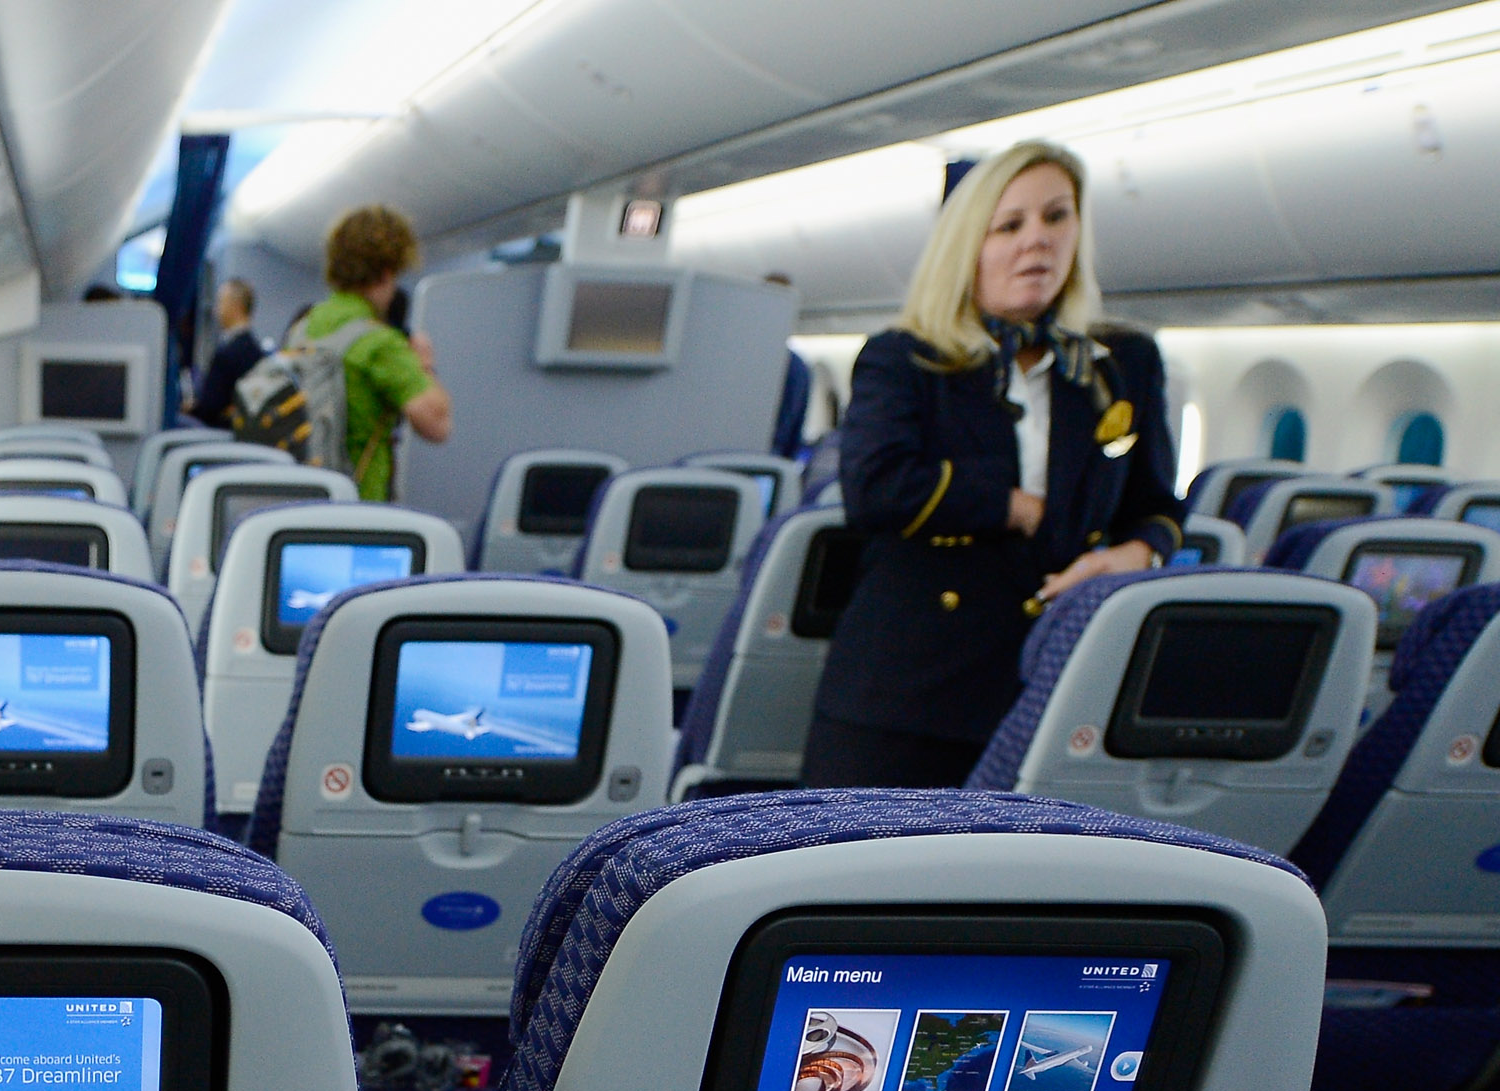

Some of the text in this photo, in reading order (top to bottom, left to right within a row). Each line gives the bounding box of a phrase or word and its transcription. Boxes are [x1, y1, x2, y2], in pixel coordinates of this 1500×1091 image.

[786, 967, 882, 982] Main menu
[1082, 966, 1140, 975] UNITED
[65, 1003, 117, 1012] UNITED
[33, 1055, 72, 1065] aboard
[75, 1054, 121, 1065] United's
[22, 1067, 122, 1084] Dreamliner
